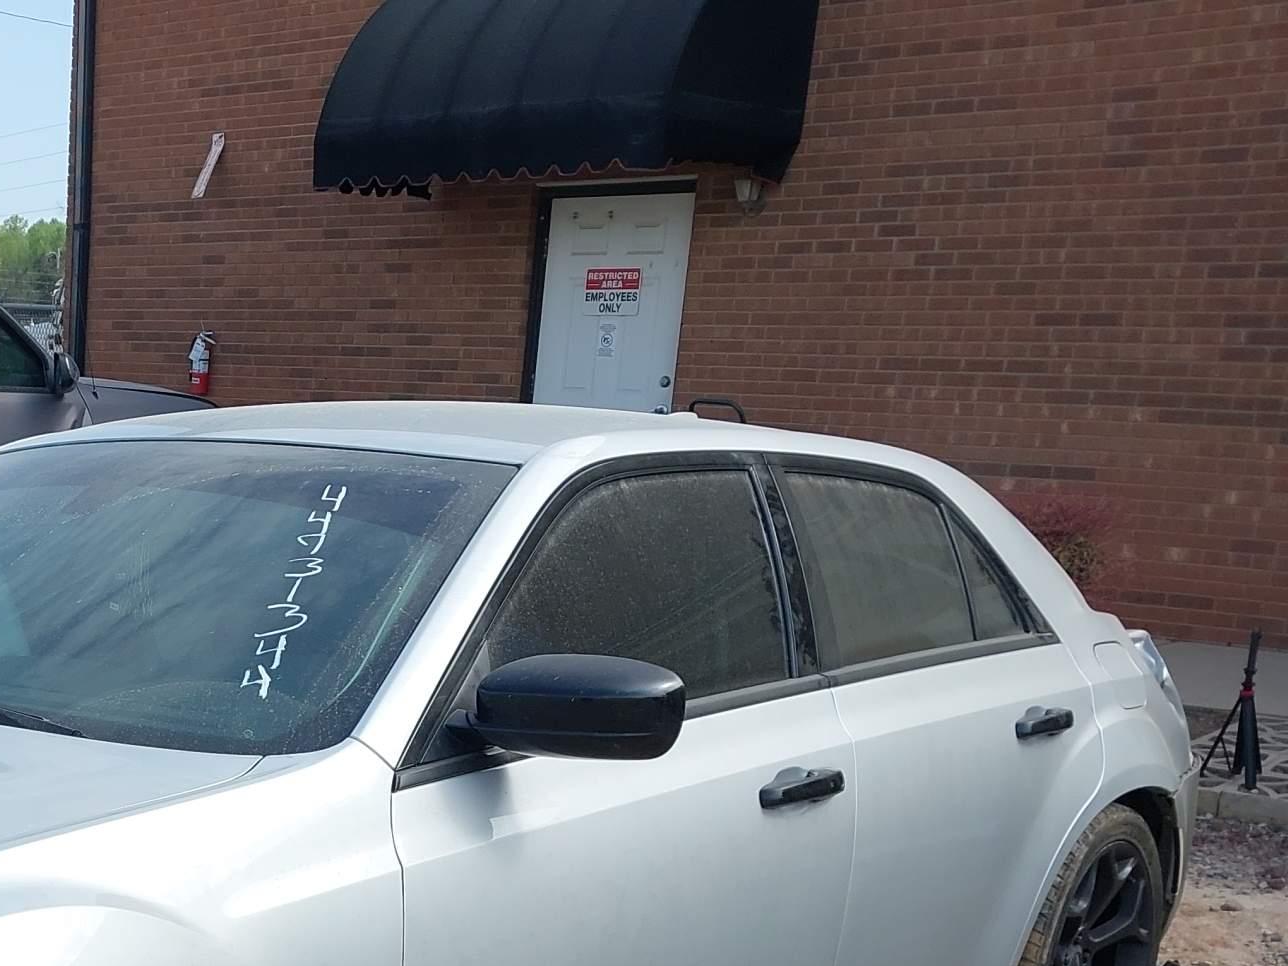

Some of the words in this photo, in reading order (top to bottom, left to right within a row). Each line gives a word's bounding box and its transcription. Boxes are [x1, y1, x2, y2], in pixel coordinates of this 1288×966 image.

[588, 272, 639, 280] RESTRICTED
[601, 280, 623, 288] AREA
[584, 292, 638, 302] EMPLOYEES
[599, 302, 622, 313] ONLY
